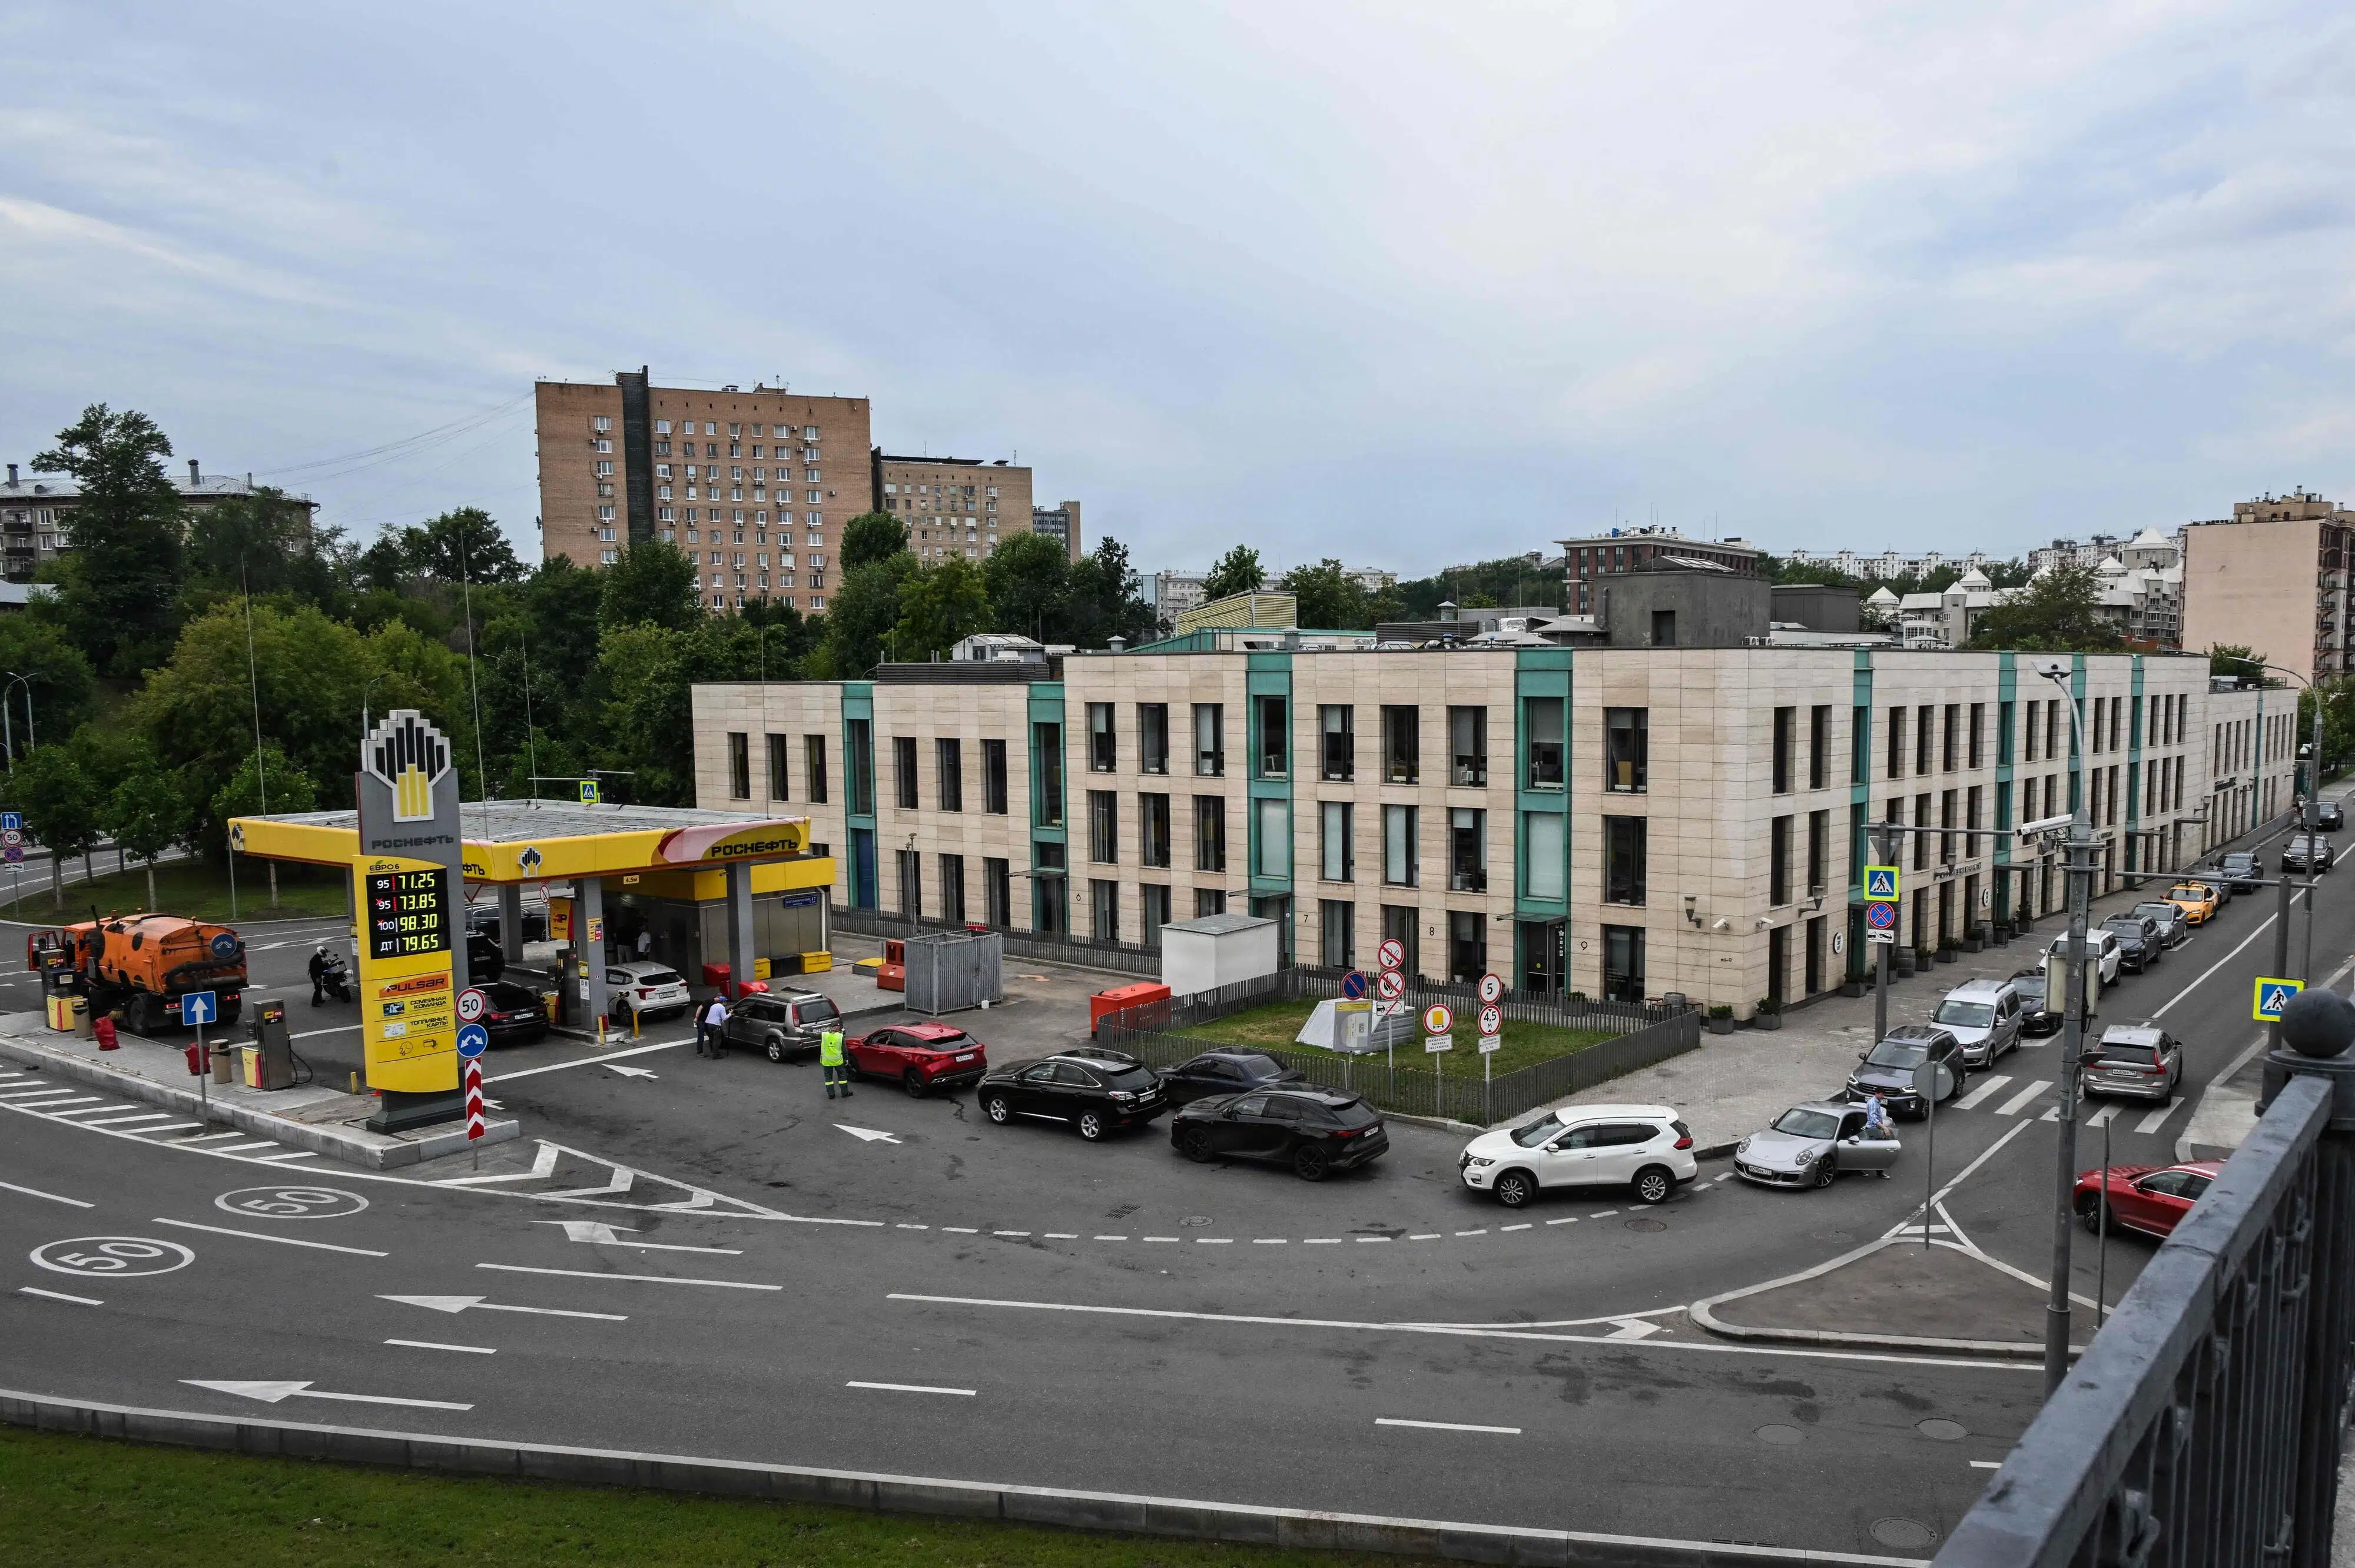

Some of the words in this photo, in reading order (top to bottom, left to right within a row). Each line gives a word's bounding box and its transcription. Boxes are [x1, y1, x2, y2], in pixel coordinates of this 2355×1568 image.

[372, 835, 454, 849] РОСНЕФТЬ
[711, 839, 798, 857] РОСНЕФТЬ
[377, 880, 390, 889] 95
[398, 872, 435, 889] 71.25
[379, 901, 391, 910] 95
[399, 893, 436, 910] 73.85
[1076, 893, 1081, 901] 6
[379, 921, 394, 931] 100
[400, 913, 437, 932] 98.30
[1303, 914, 1308, 923] 7
[1429, 926, 1434, 936] 8
[380, 941, 393, 952] ДТ
[402, 934, 439, 951] 79.65
[1581, 941, 1588, 951] 9
[1487, 983, 1493, 995] 5
[410, 996, 447, 1005] СЕМЕЙНАЯ
[414, 1001, 447, 1009] КОМАНДА
[462, 999, 478, 1013] 50
[410, 1016, 447, 1026] ТОПЛИВНЫЕ
[1484, 1011, 1496, 1023] 4,5
[241, 1191, 339, 1214] 50
[56, 1243, 164, 1270] 50
